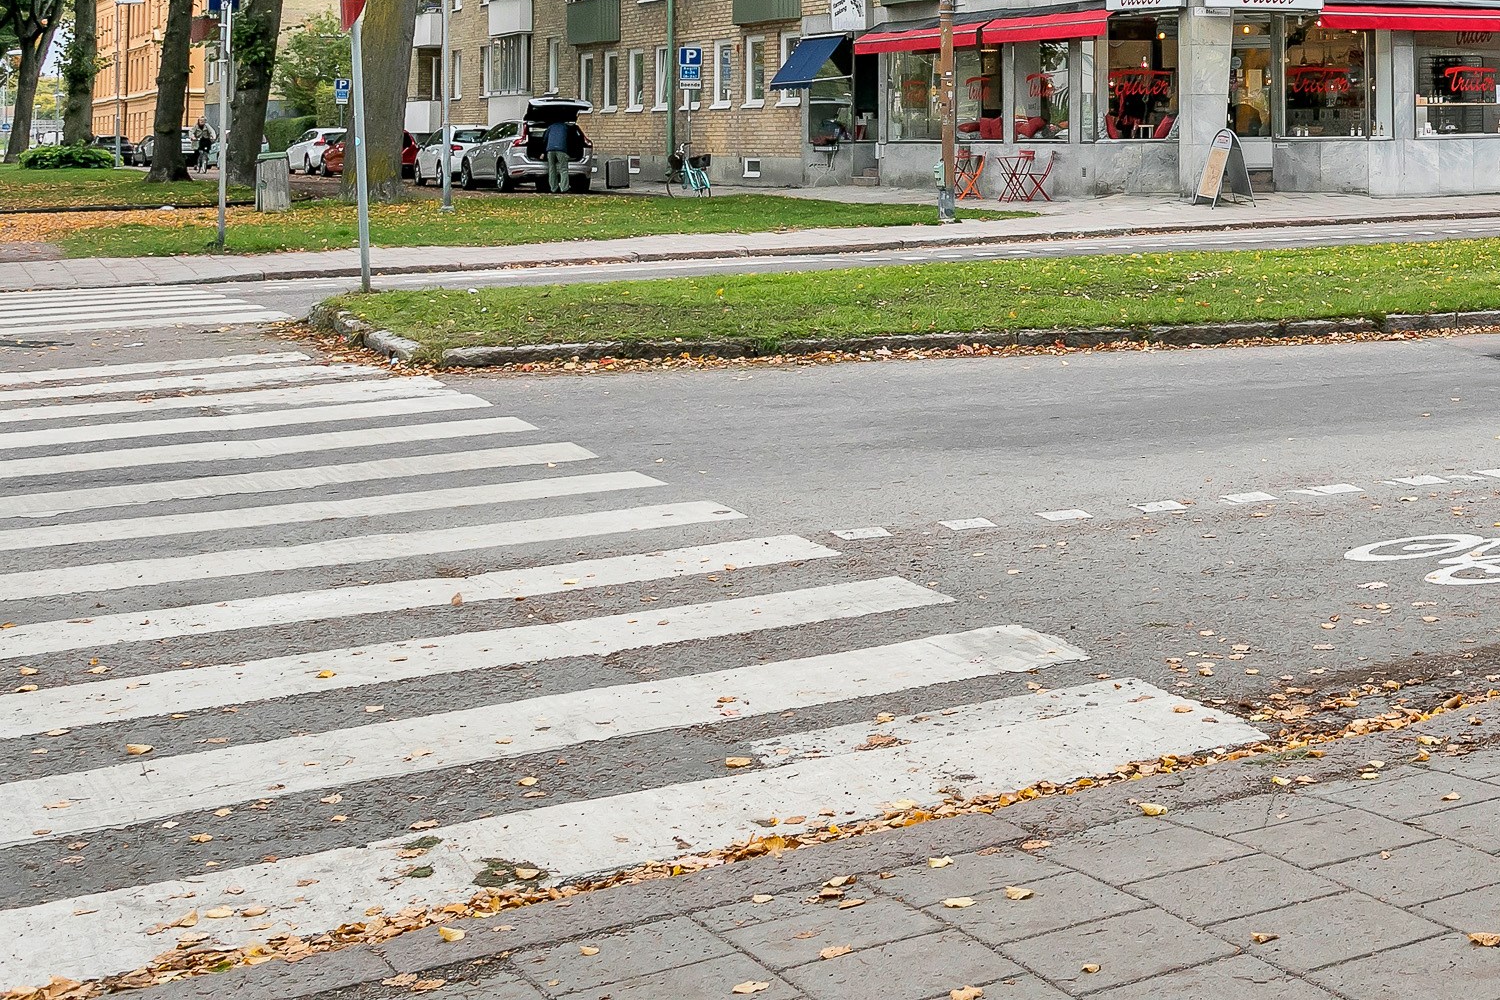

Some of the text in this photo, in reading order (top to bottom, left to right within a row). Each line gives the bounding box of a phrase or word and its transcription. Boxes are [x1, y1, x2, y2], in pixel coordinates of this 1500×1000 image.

[686, 50, 697, 63] P
[339, 80, 347, 89] P
[1444, 65, 1497, 92] Triller
